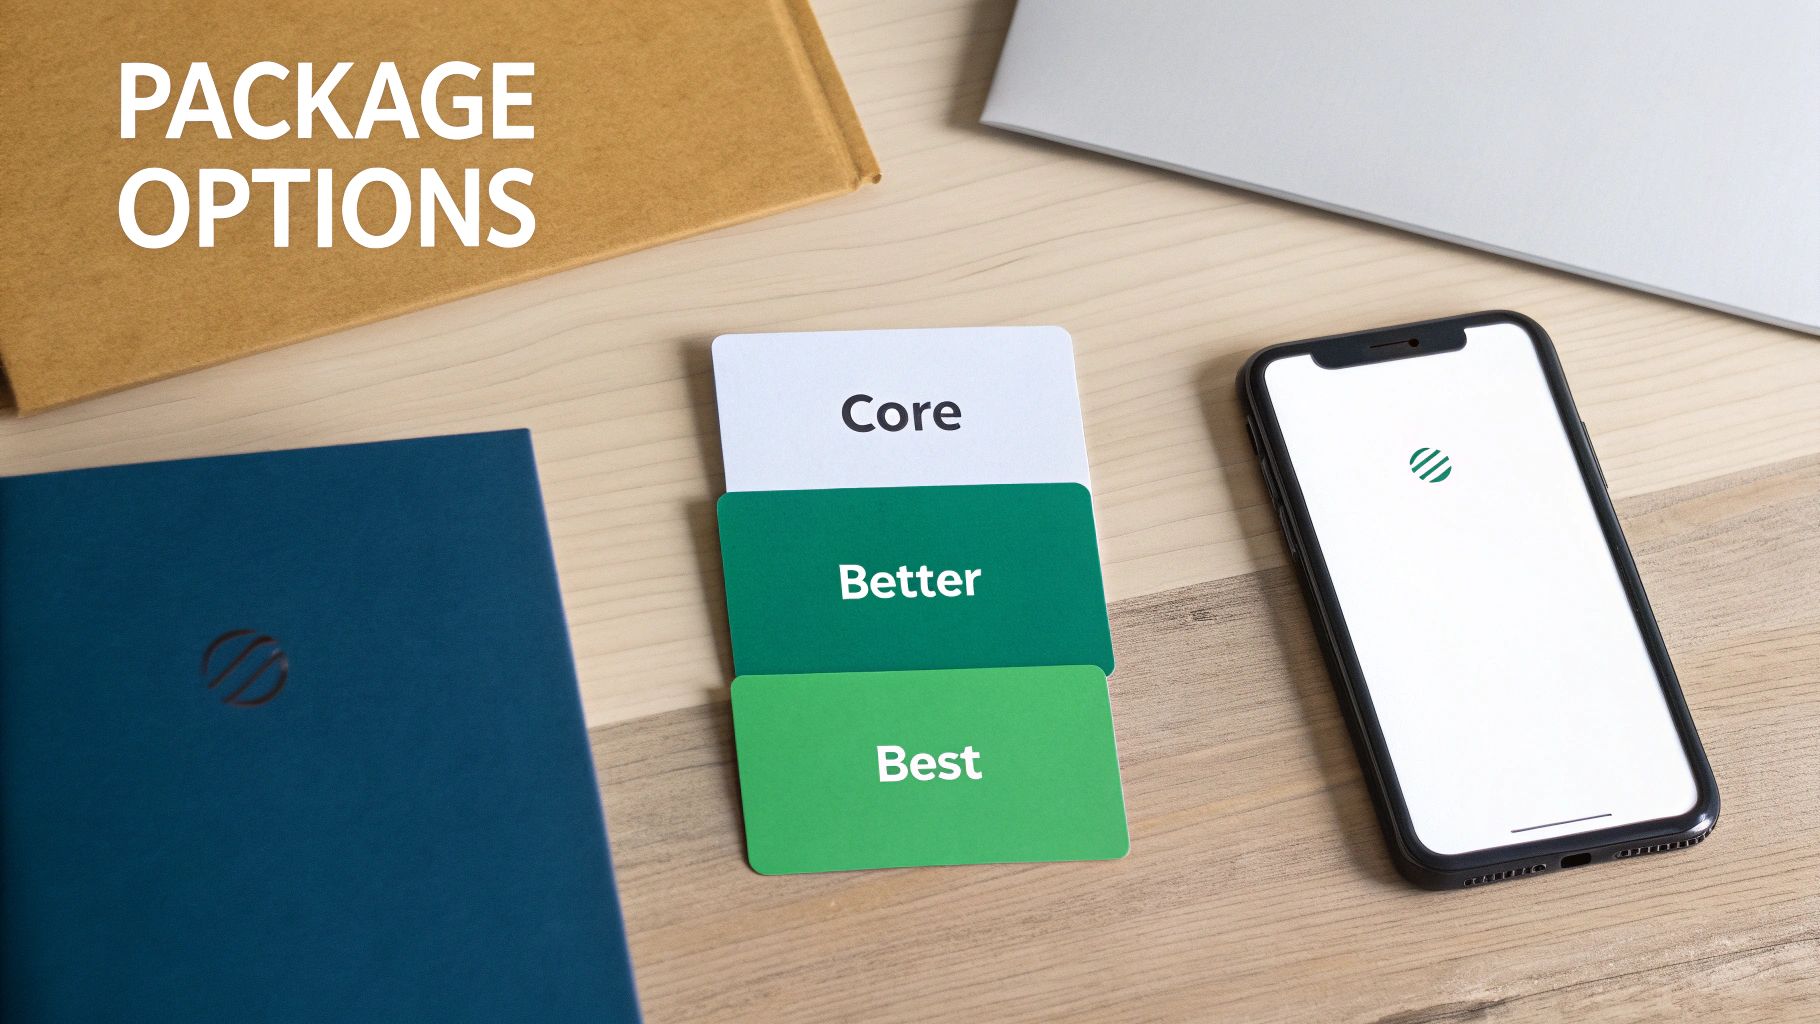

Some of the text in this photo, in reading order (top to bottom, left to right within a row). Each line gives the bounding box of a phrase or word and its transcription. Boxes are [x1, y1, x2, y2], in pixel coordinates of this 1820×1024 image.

[841, 393, 962, 433] Core
[839, 564, 982, 600] Better
[876, 745, 983, 783] Best
